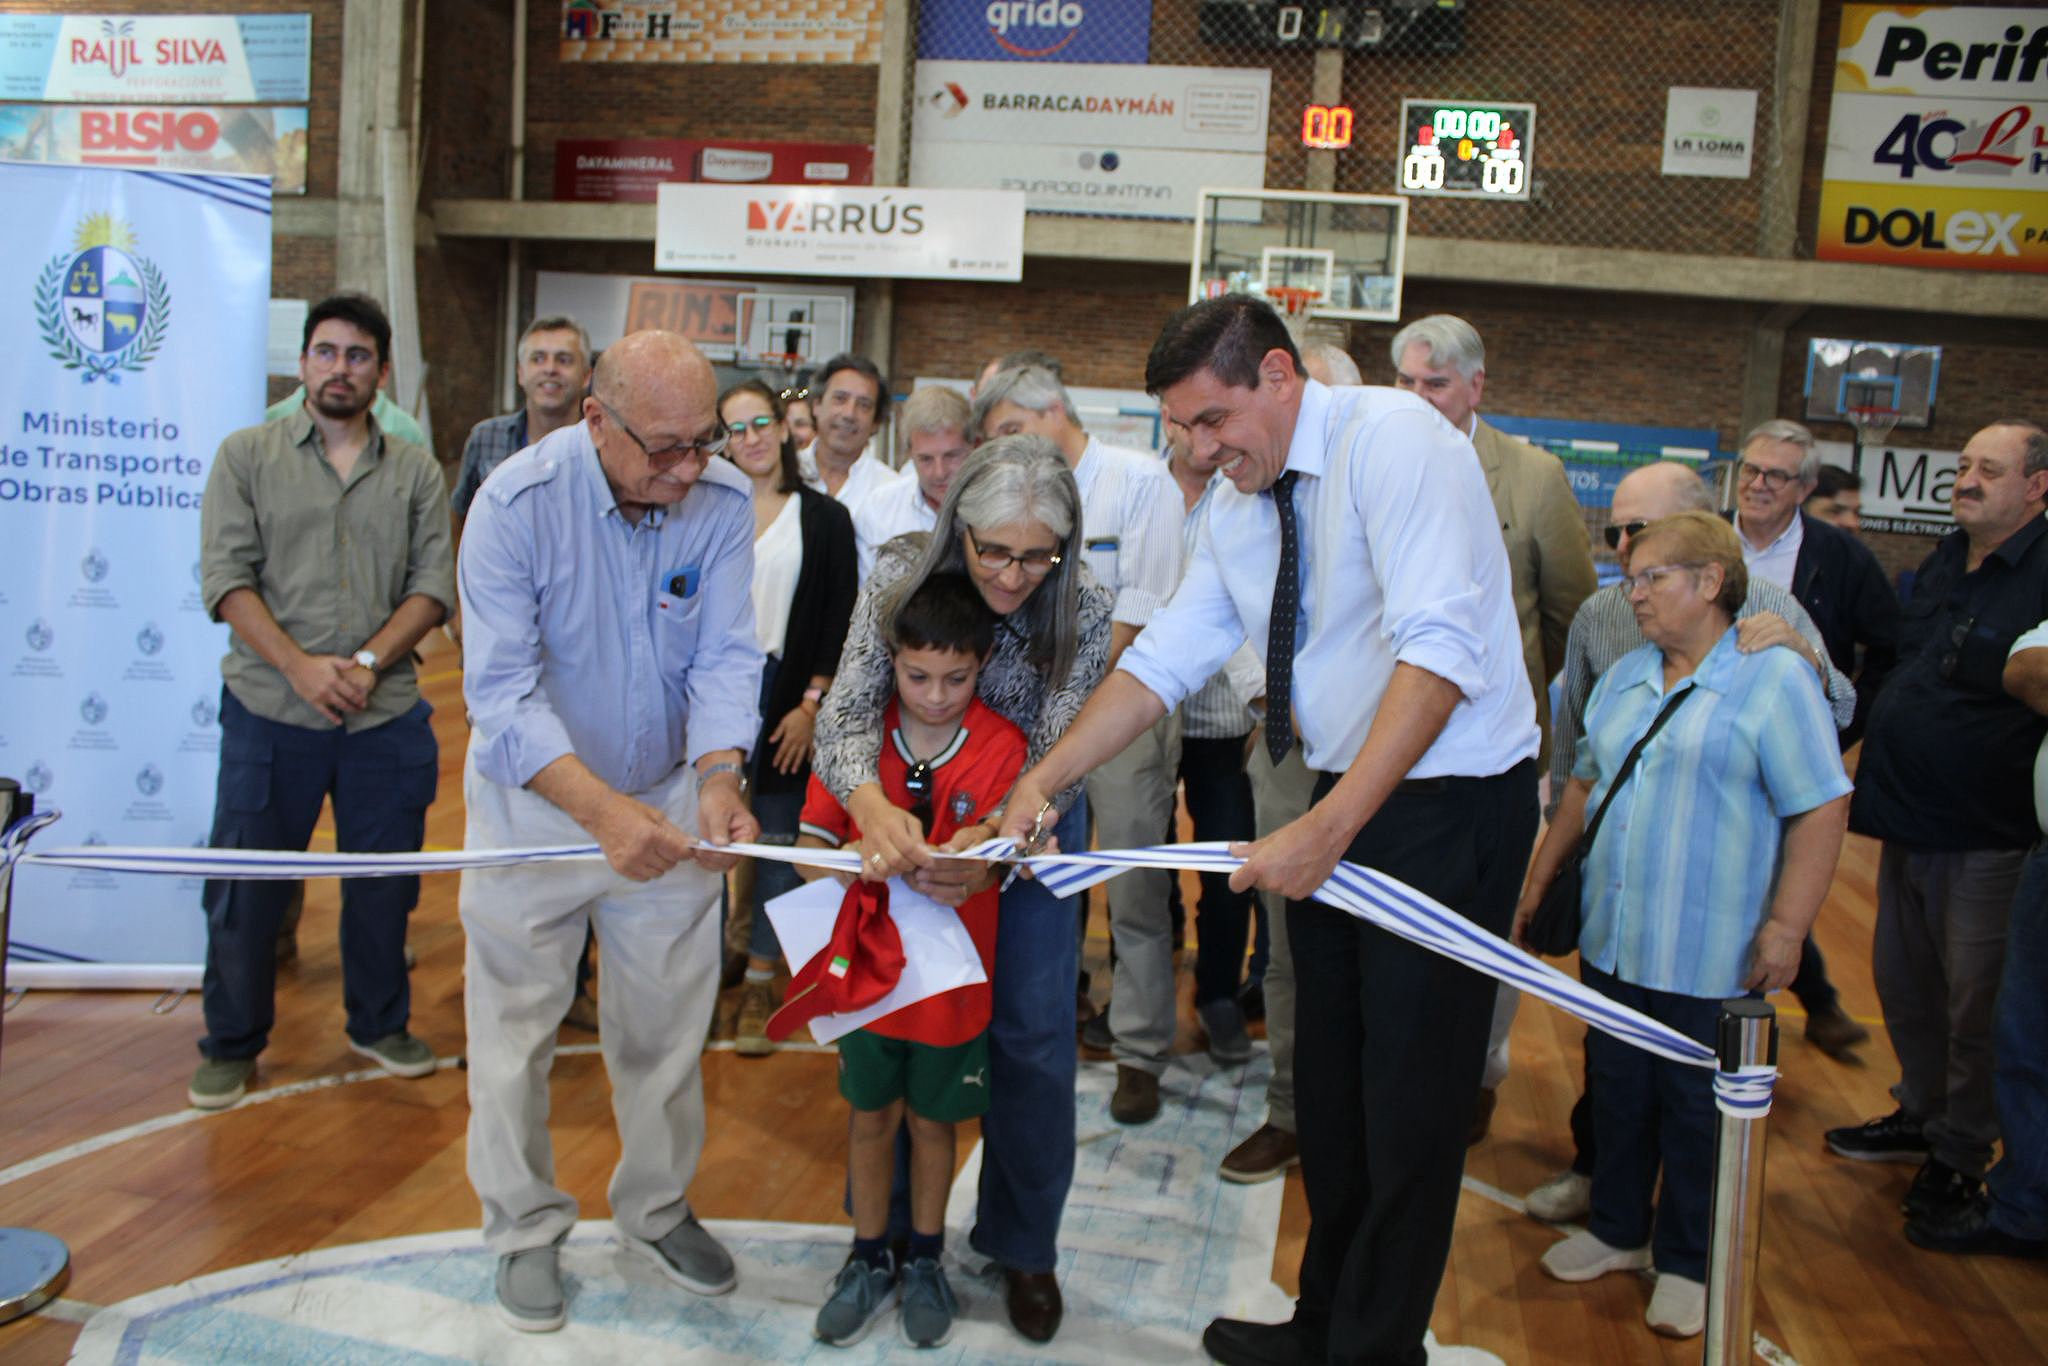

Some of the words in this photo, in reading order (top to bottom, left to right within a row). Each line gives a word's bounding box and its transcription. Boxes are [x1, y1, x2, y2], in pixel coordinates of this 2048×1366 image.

[986, 0, 1083, 35] grido
[156, 38, 227, 65] SILVA
[1875, 25, 2048, 82] Perif
[81, 112, 219, 152] BISIO
[1674, 138, 1692, 151] LA
[1698, 140, 1745, 155] LOMA
[22, 411, 179, 441] Ministerio
[37, 446, 203, 476] Transporte
[0, 478, 88, 503] Obras
